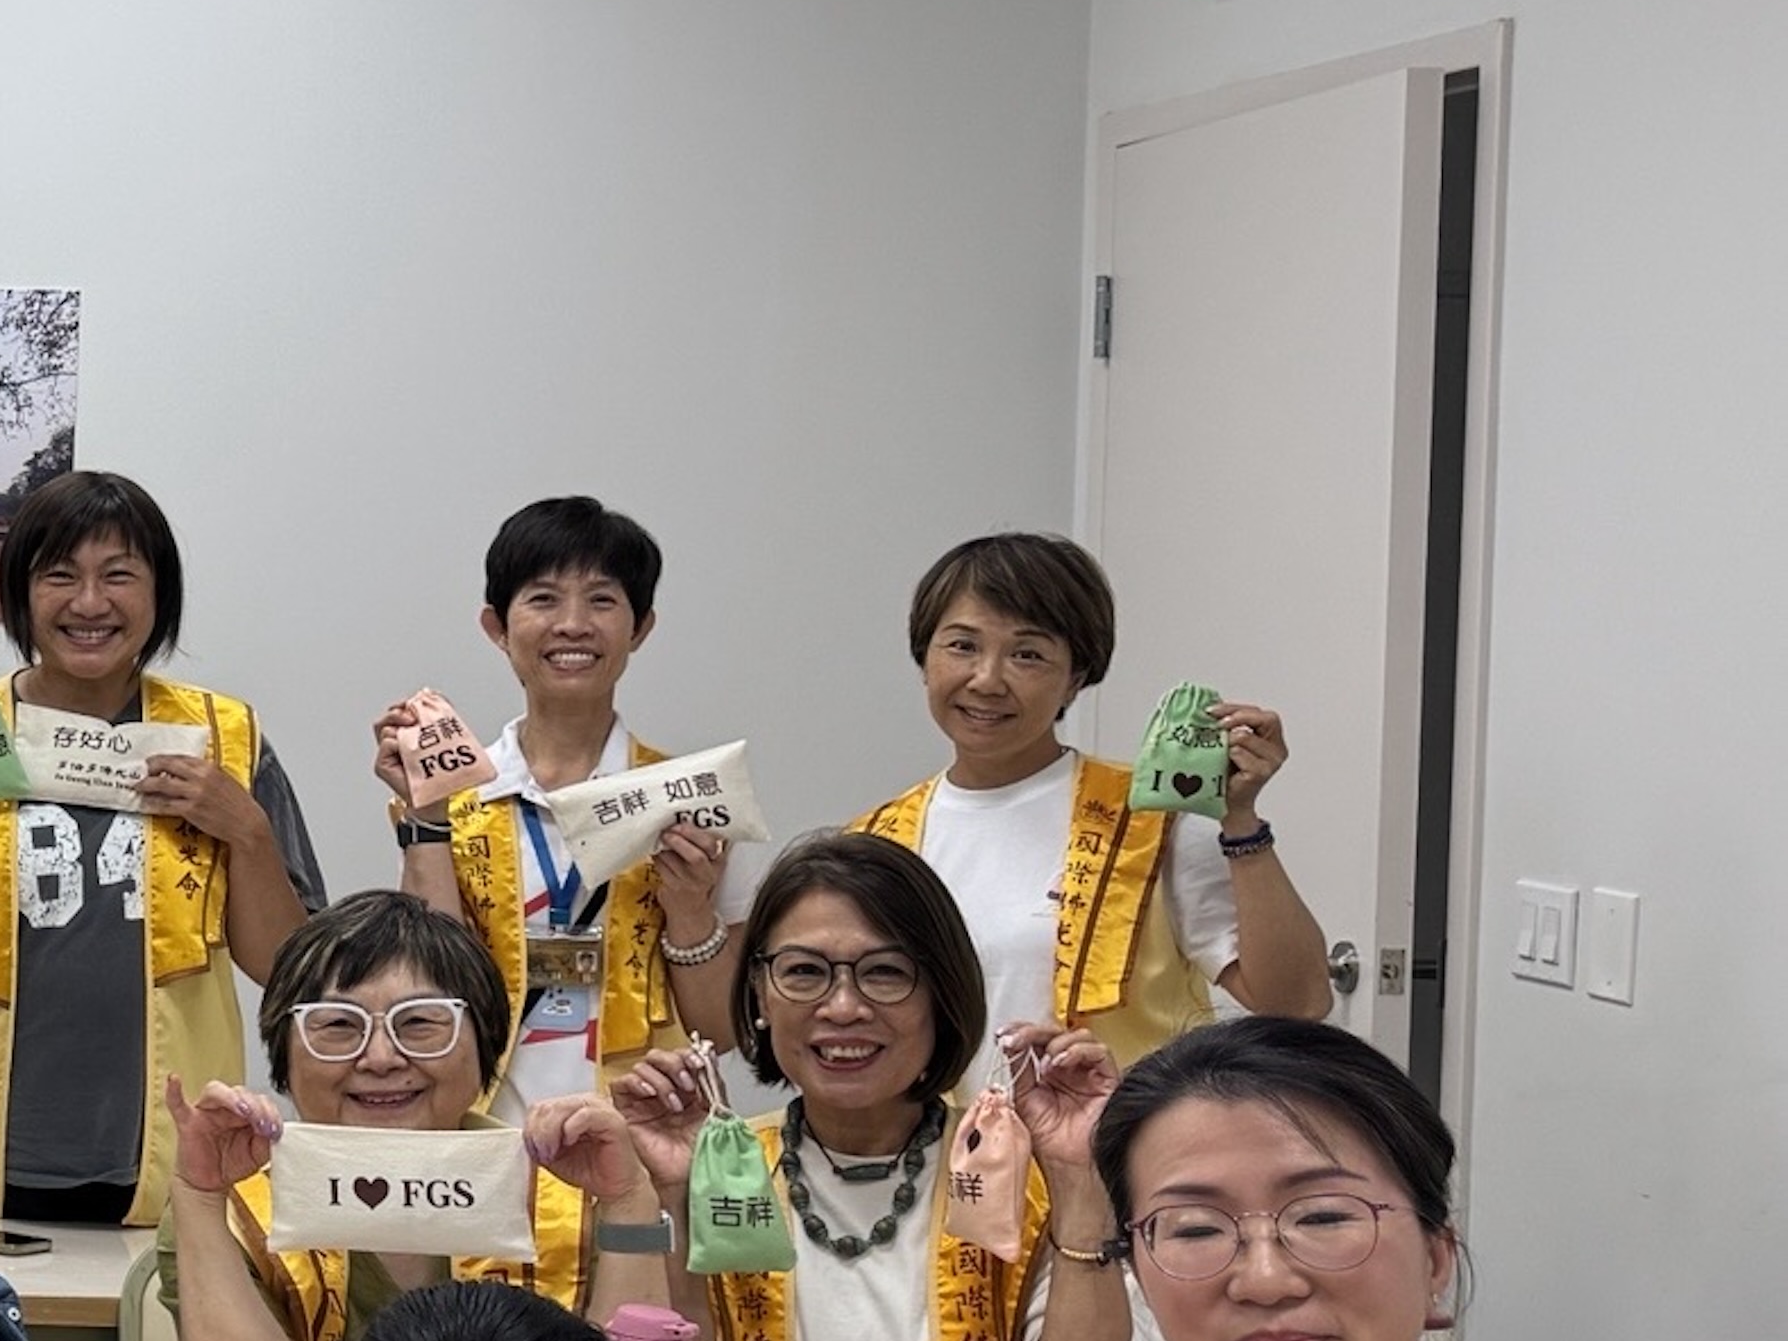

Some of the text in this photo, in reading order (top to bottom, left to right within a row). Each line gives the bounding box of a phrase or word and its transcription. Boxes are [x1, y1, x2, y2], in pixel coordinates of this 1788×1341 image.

[54, 726, 132, 754] 存好心
[419, 717, 463, 750] 吉祥
[420, 745, 476, 779] FGS
[1150, 770, 1165, 793] I
[592, 772, 723, 825] 吉祥 如意
[675, 804, 731, 829] FGS
[328, 1177, 476, 1208] I FGS
[709, 1195, 776, 1229] 吉祥
